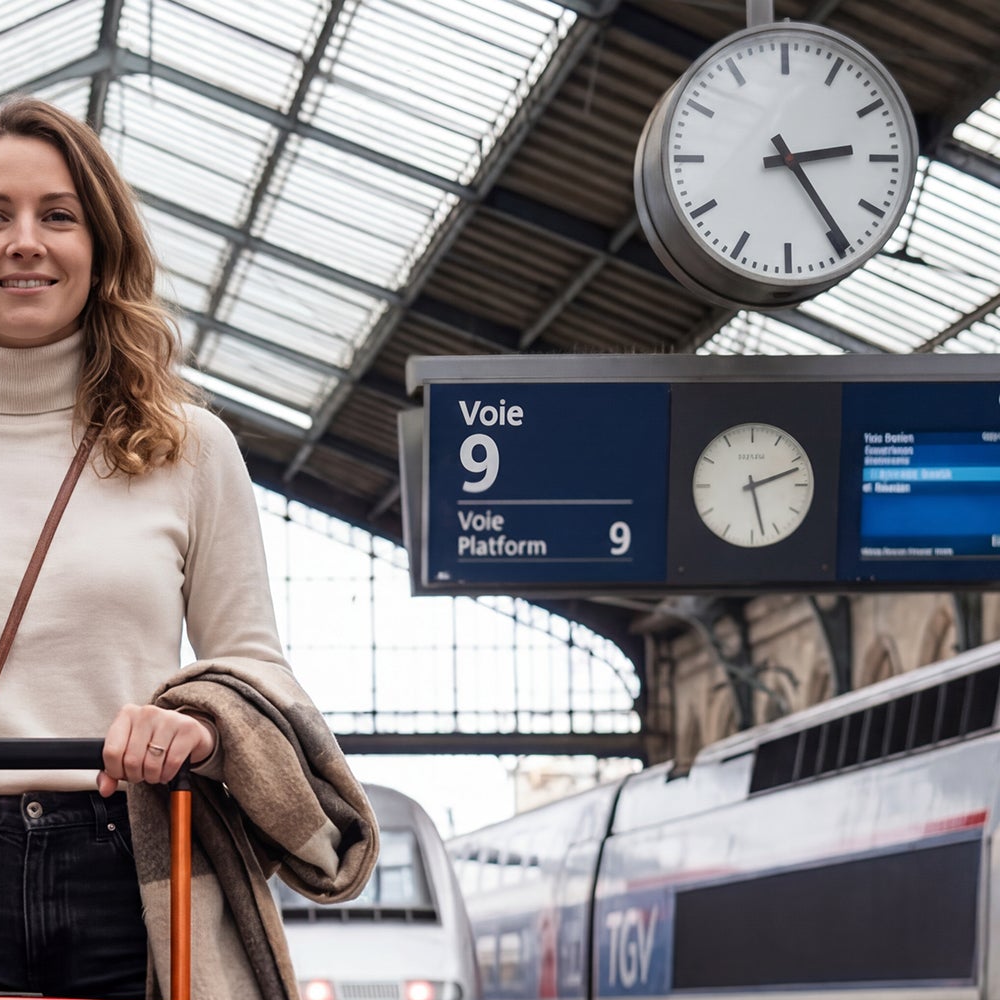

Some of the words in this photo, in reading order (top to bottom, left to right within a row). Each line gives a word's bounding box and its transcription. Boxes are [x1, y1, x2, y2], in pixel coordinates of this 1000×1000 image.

[458, 399, 524, 427] Voie
[459, 433, 500, 493] 9
[457, 510, 505, 532] Voie
[457, 534, 547, 557] Platform
[609, 521, 631, 556] 9
[606, 904, 659, 989] TGV
